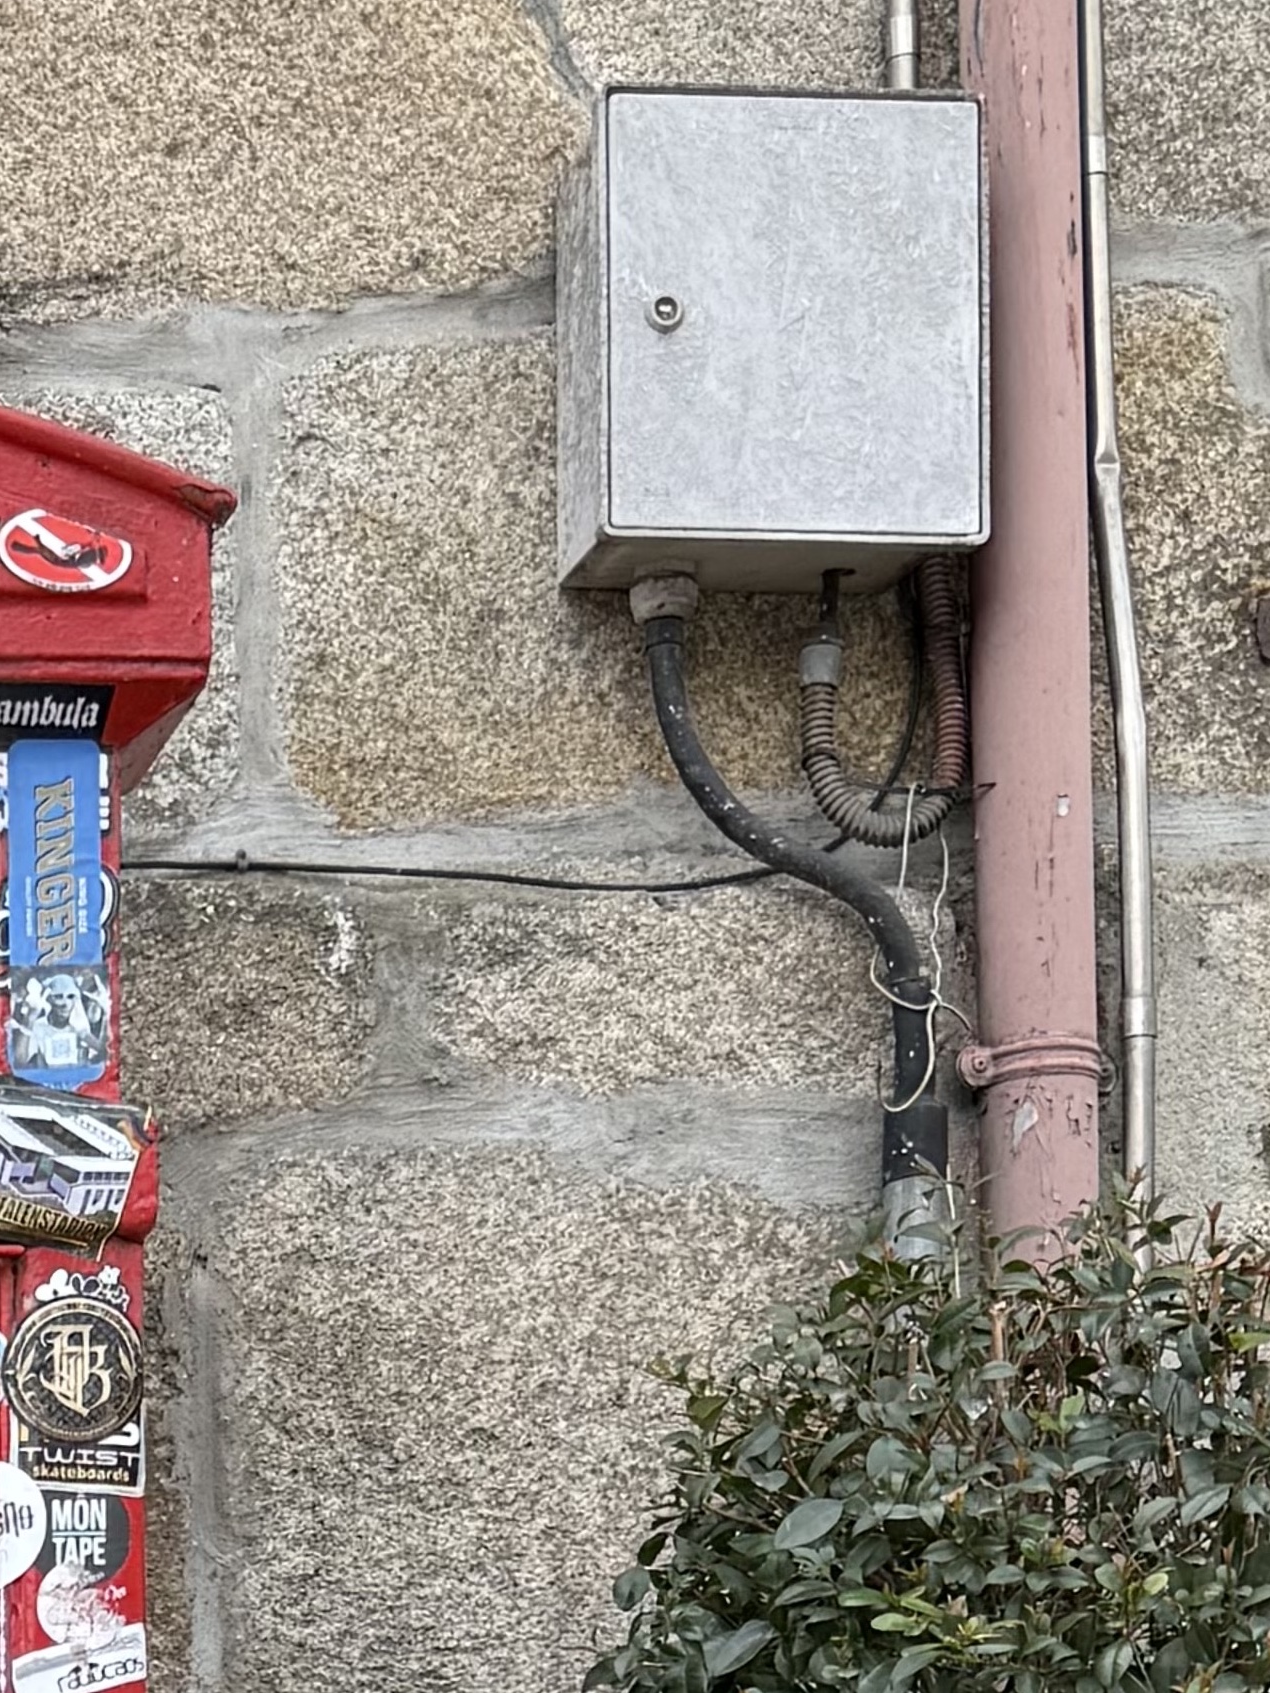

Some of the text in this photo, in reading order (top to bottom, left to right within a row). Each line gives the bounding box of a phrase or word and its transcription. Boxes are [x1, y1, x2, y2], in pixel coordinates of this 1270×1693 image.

[34, 776, 75, 968] KINGER
[19, 1446, 141, 1465] TWIST
[32, 1465, 131, 1484] skateboards
[52, 1536, 107, 1567] TAPE
